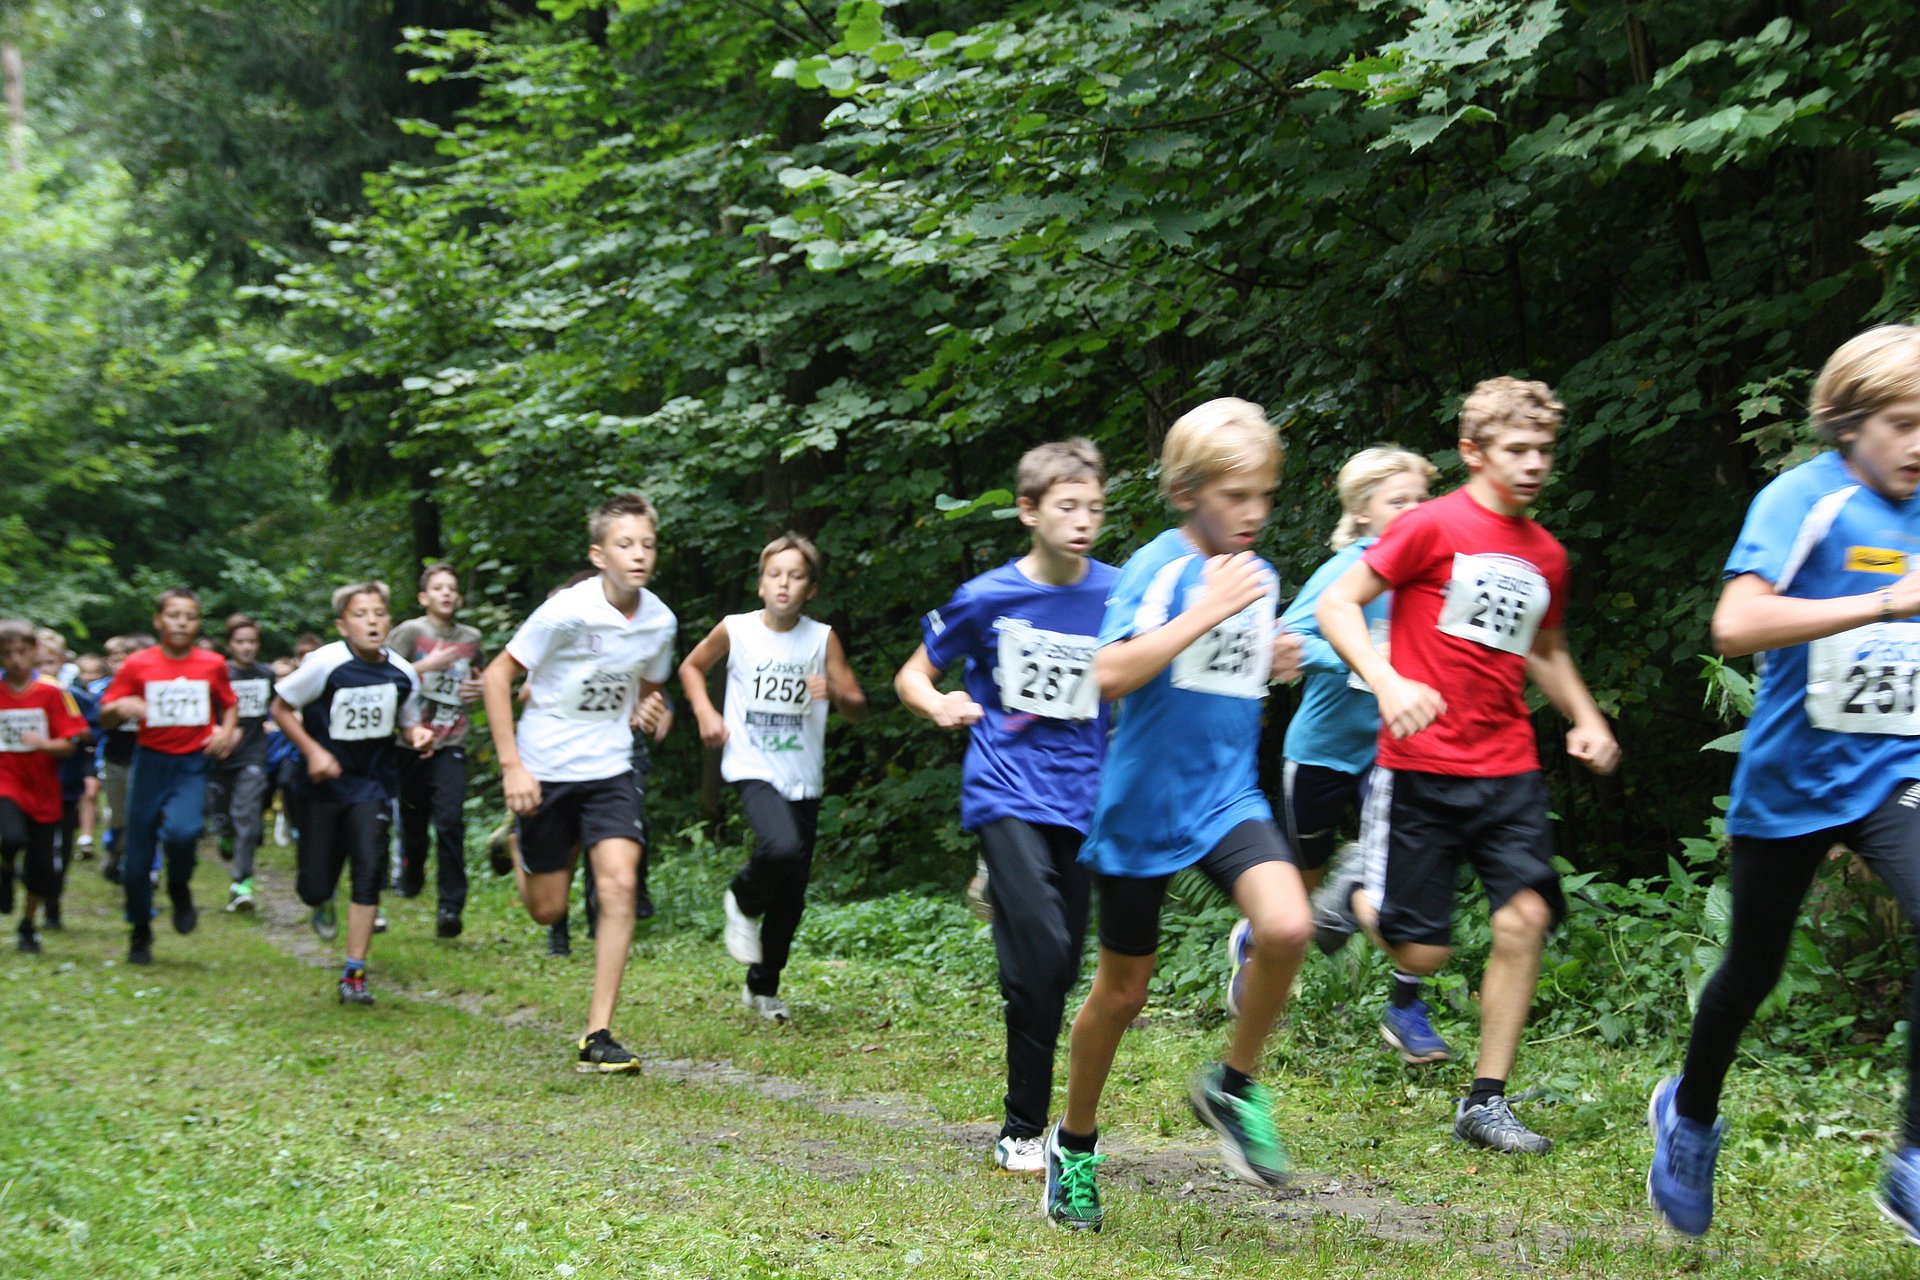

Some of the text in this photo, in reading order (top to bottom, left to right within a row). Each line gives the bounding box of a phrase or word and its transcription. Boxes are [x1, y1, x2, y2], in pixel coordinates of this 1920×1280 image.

[753, 673, 807, 704] 1252
[1020, 661, 1085, 706] 287
[155, 697, 199, 718] 1271
[345, 706, 382, 730] 259
